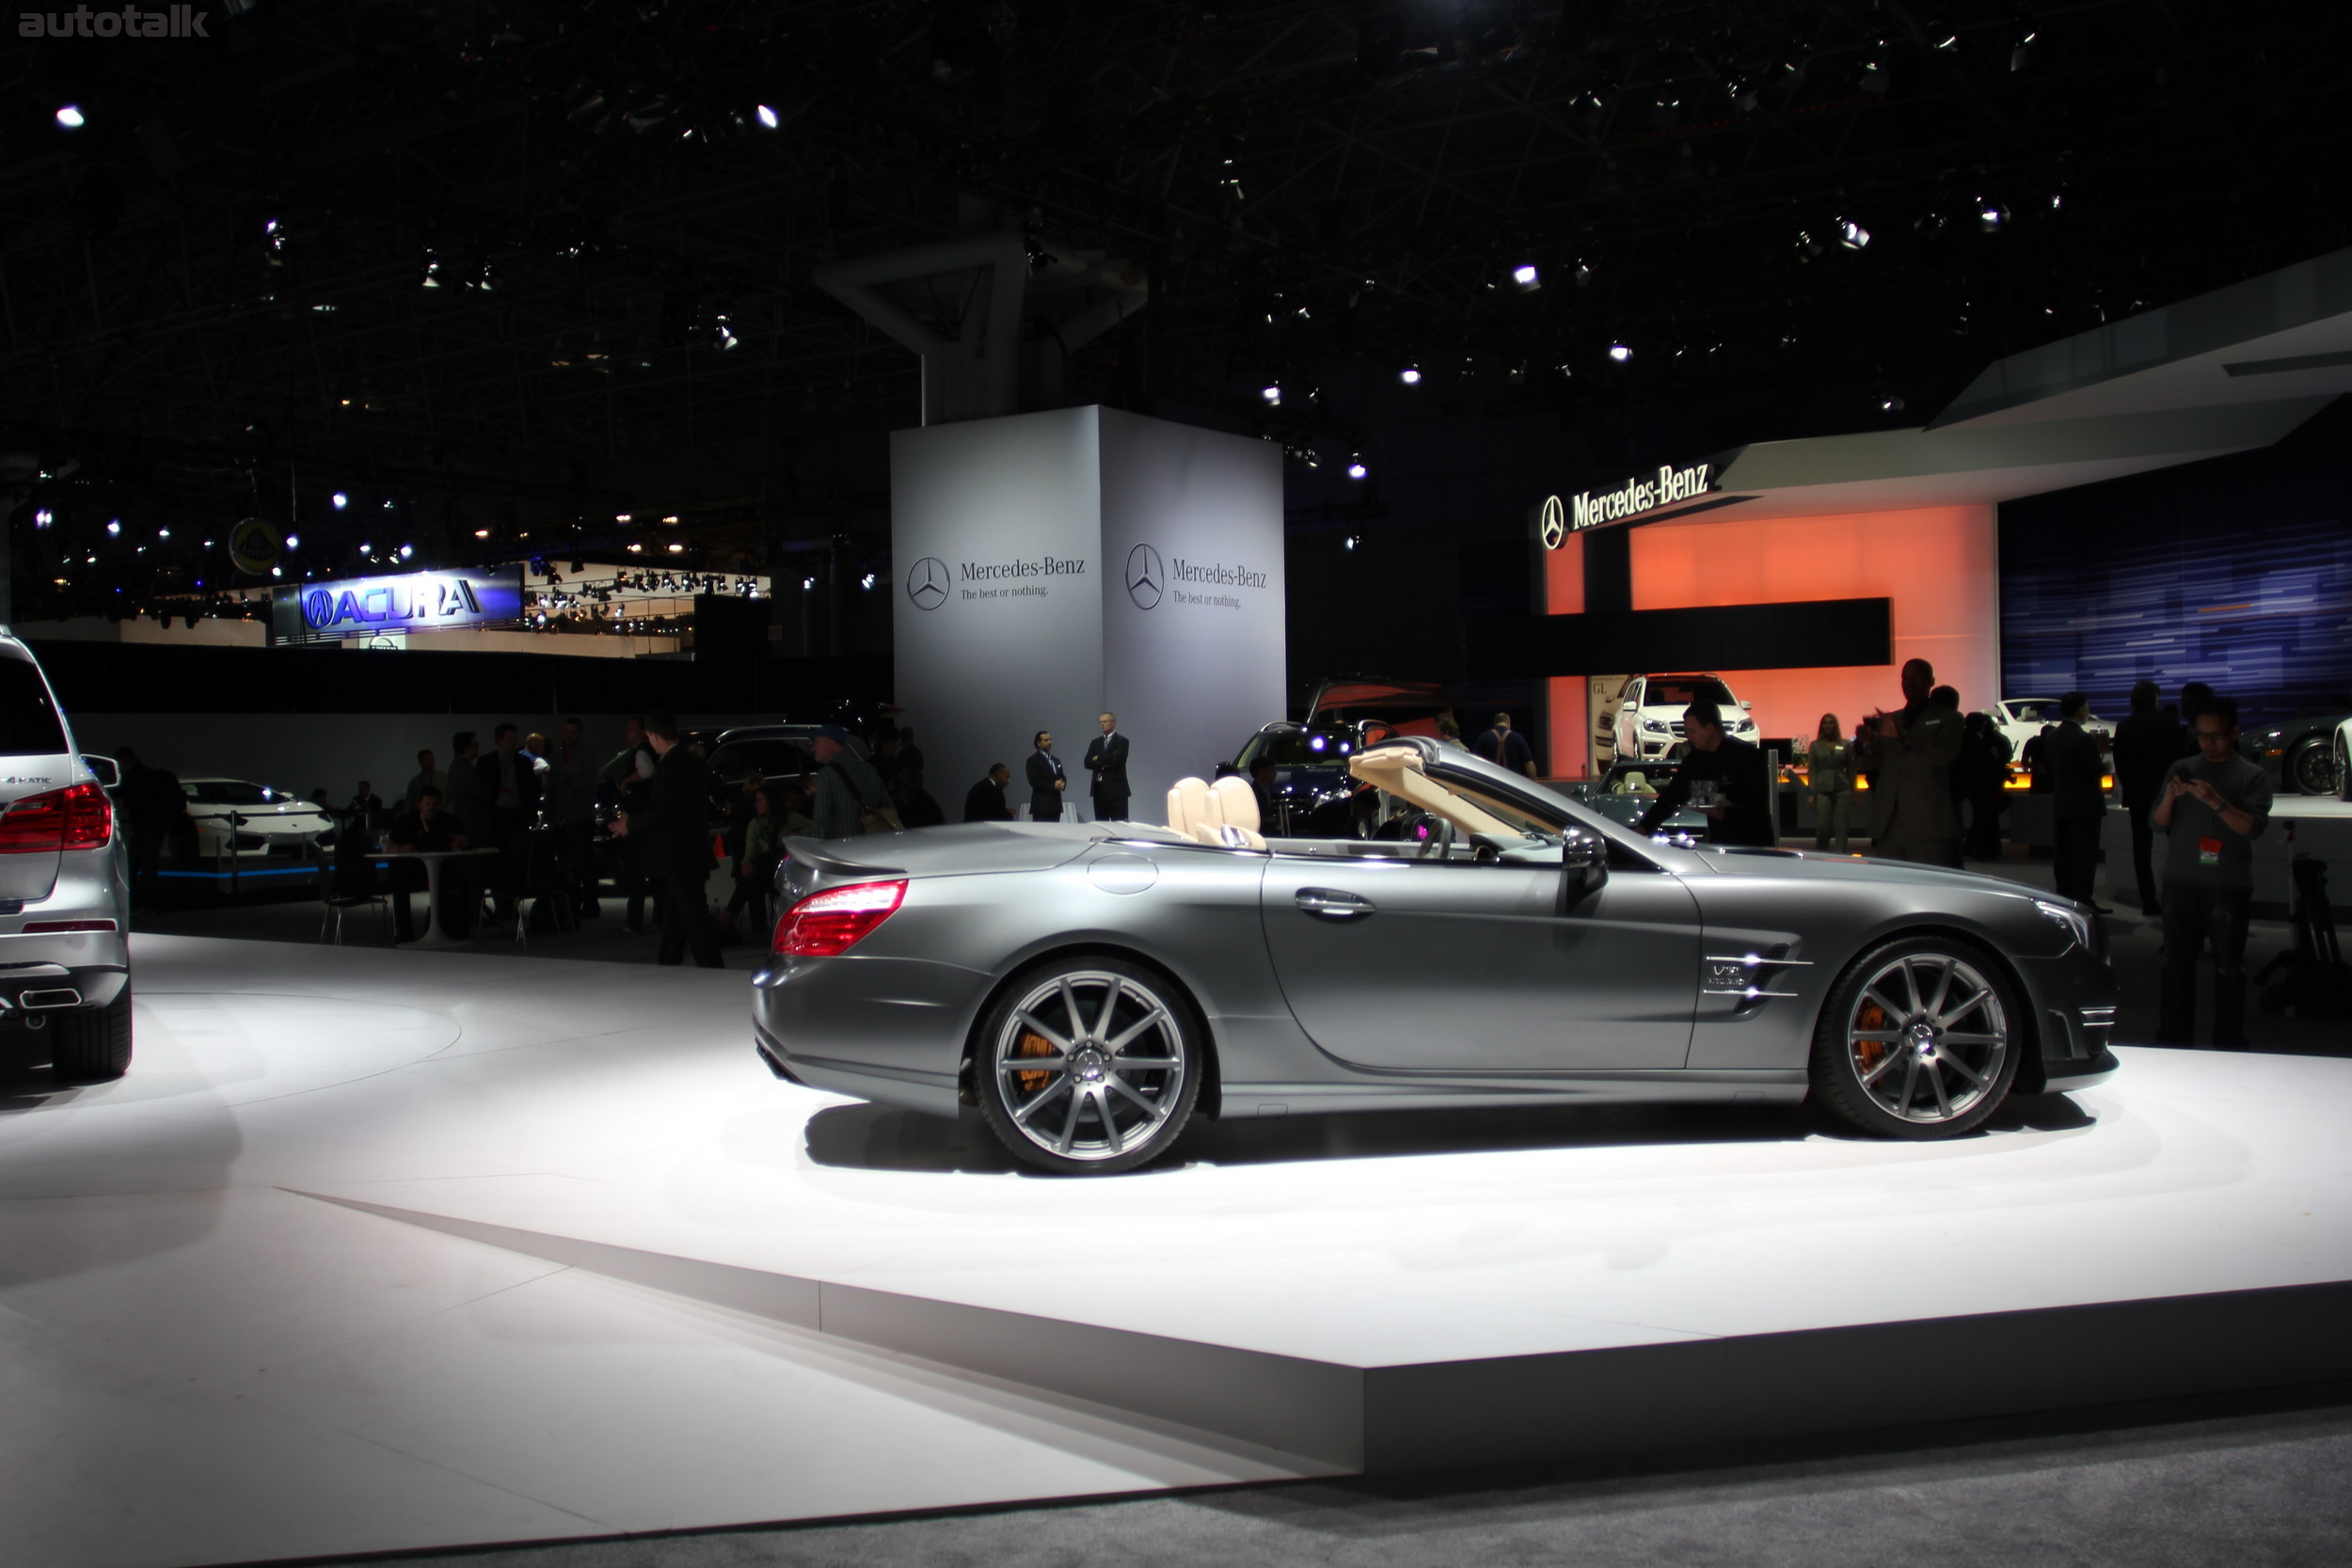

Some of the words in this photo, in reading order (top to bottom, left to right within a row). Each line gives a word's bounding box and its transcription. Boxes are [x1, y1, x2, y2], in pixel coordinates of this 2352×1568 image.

[1572, 464, 1709, 531] Mercedes-Benz
[961, 556, 1086, 581] Mercedes-Benz
[1172, 558, 1267, 589] Mercedes-Benz
[333, 579, 481, 625] ACURA
[961, 589, 977, 600] The
[979, 587, 997, 599] best
[999, 589, 1009, 598] or
[1011, 585, 1049, 598] nothing.
[1173, 590, 1186, 604] The
[1188, 591, 1203, 606] best
[1204, 595, 1212, 606] or
[1214, 594, 1242, 610] nothing.
[1593, 683, 1607, 694] GL
